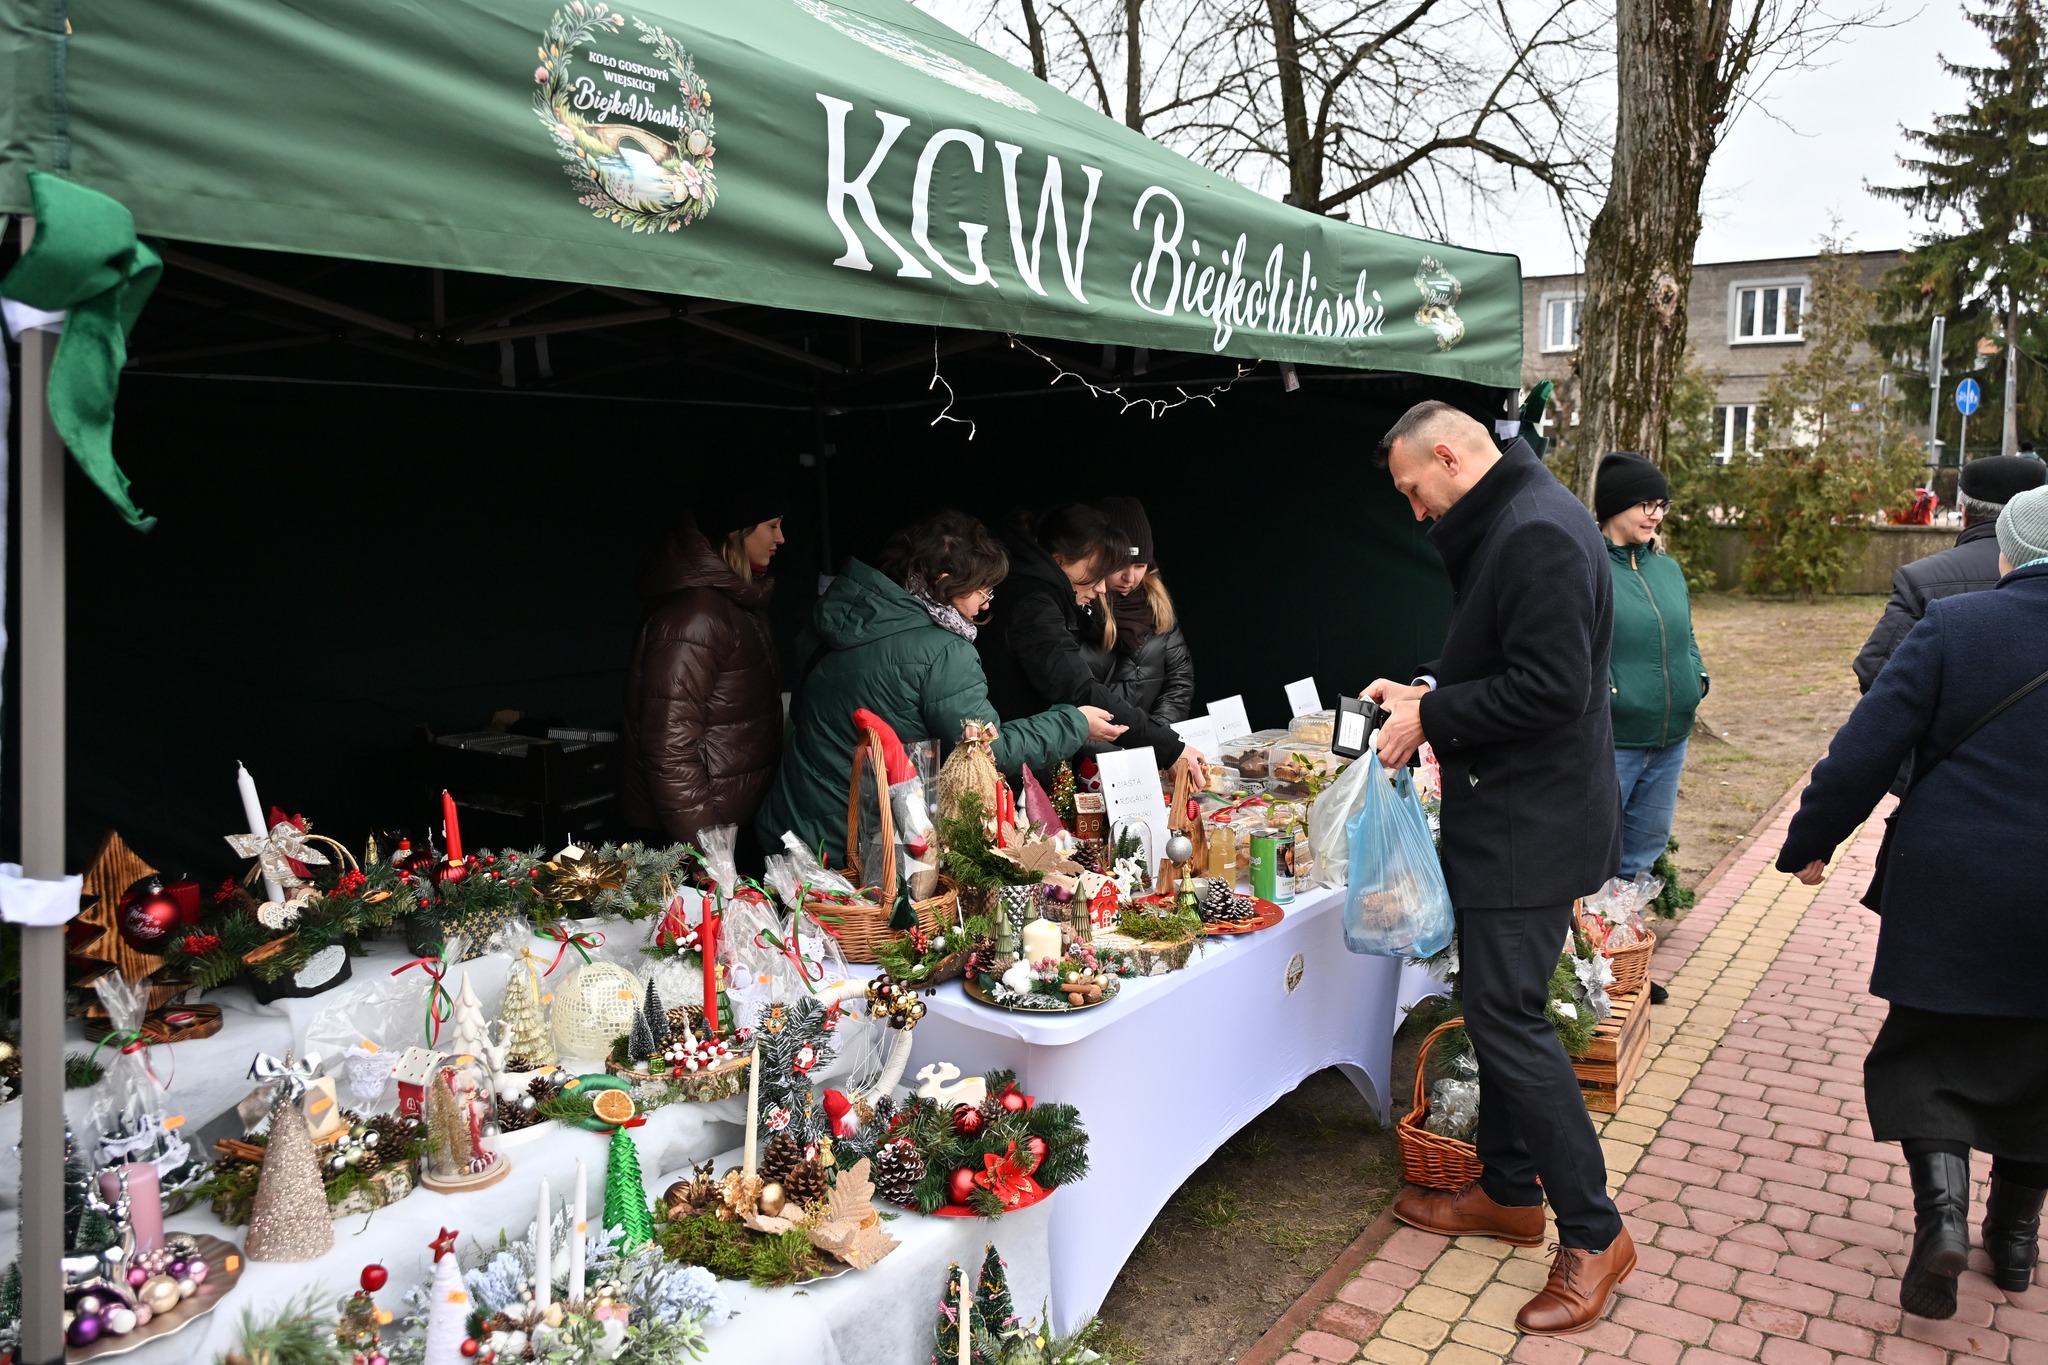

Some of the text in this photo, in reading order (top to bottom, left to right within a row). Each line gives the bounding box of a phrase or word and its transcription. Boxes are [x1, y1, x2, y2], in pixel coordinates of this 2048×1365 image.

[588, 51, 669, 82] KOŁO GOSPODYŃ
[602, 70, 656, 93] WIEJSKICH
[573, 76, 687, 128] BiejkoWianki
[815, 92, 1386, 352] KGW BiejkoWianki
[1116, 778, 1142, 789] CIASTA
[1119, 793, 1153, 805] ROGALIKI
